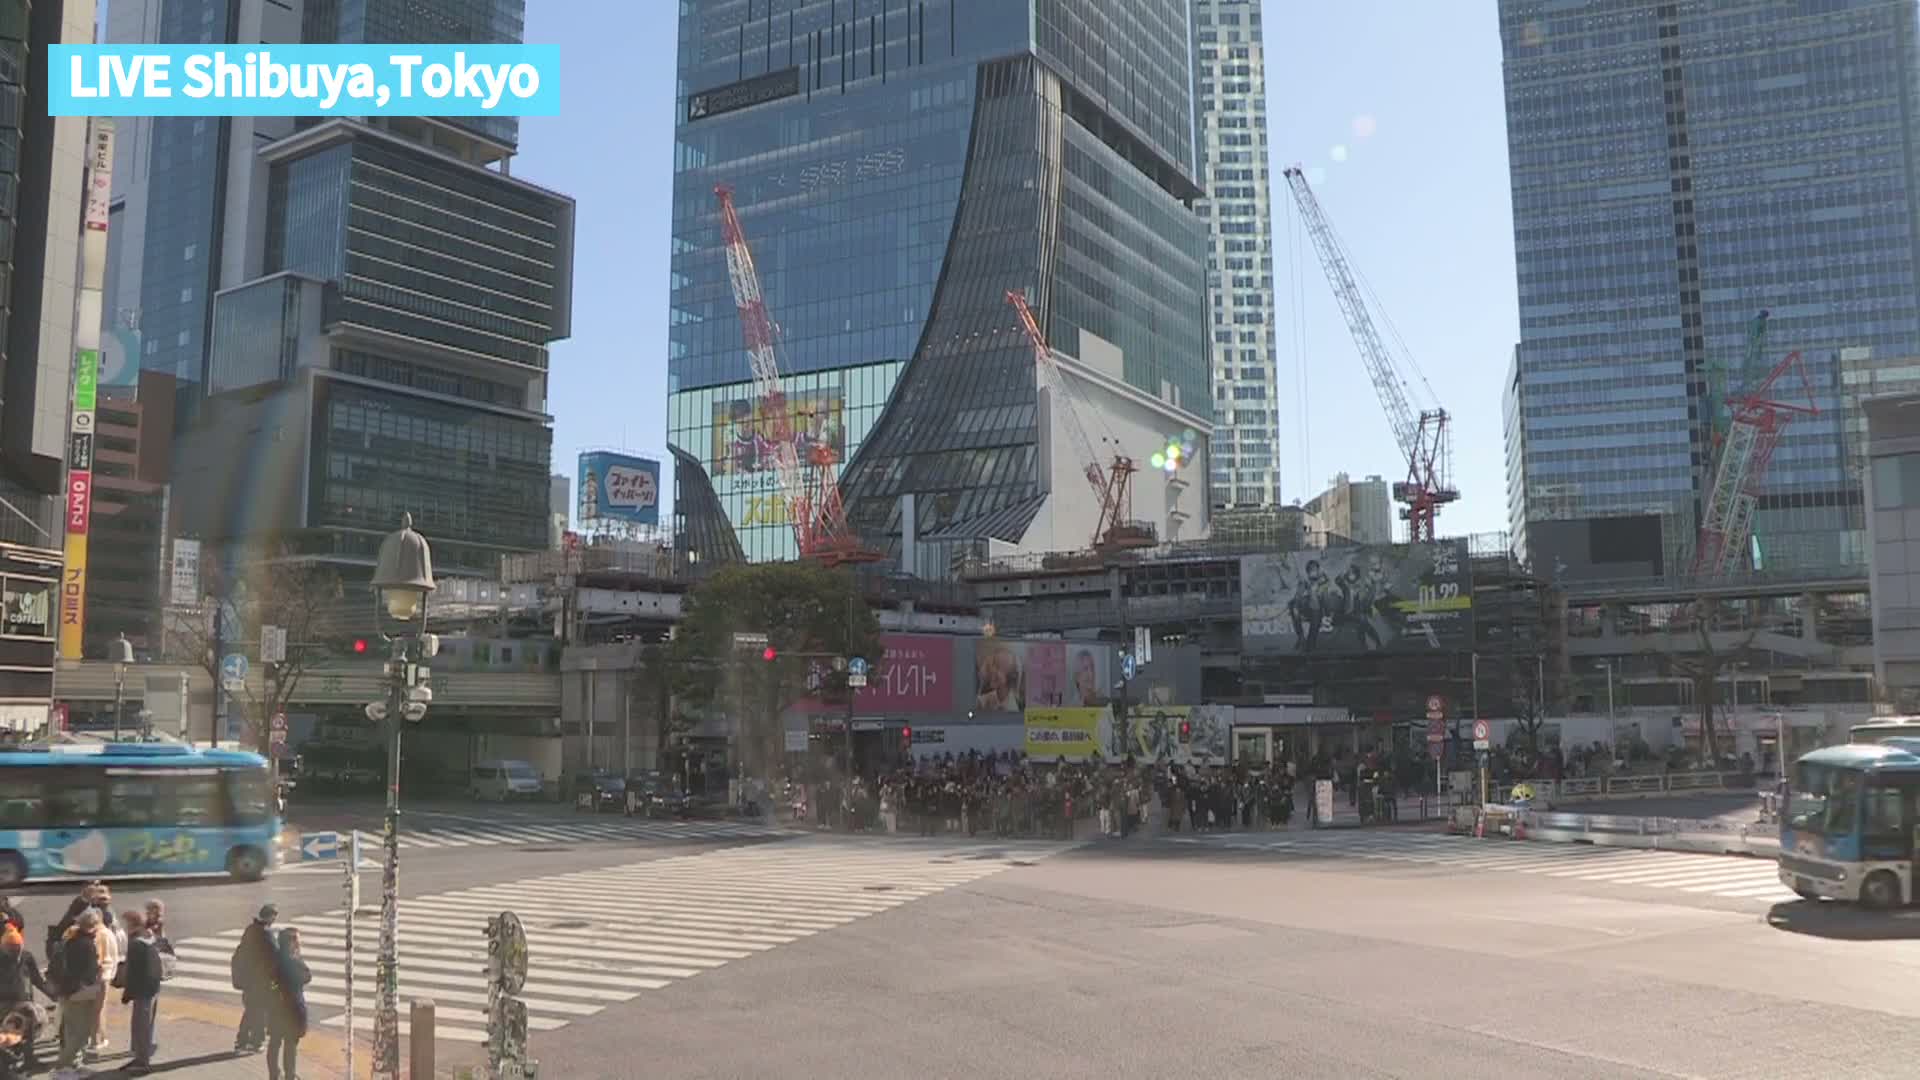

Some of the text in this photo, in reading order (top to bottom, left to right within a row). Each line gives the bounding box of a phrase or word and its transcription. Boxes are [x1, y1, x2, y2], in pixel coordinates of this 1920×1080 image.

[611, 472, 650, 488] ファイト
[64, 568, 81, 625] プロミス
